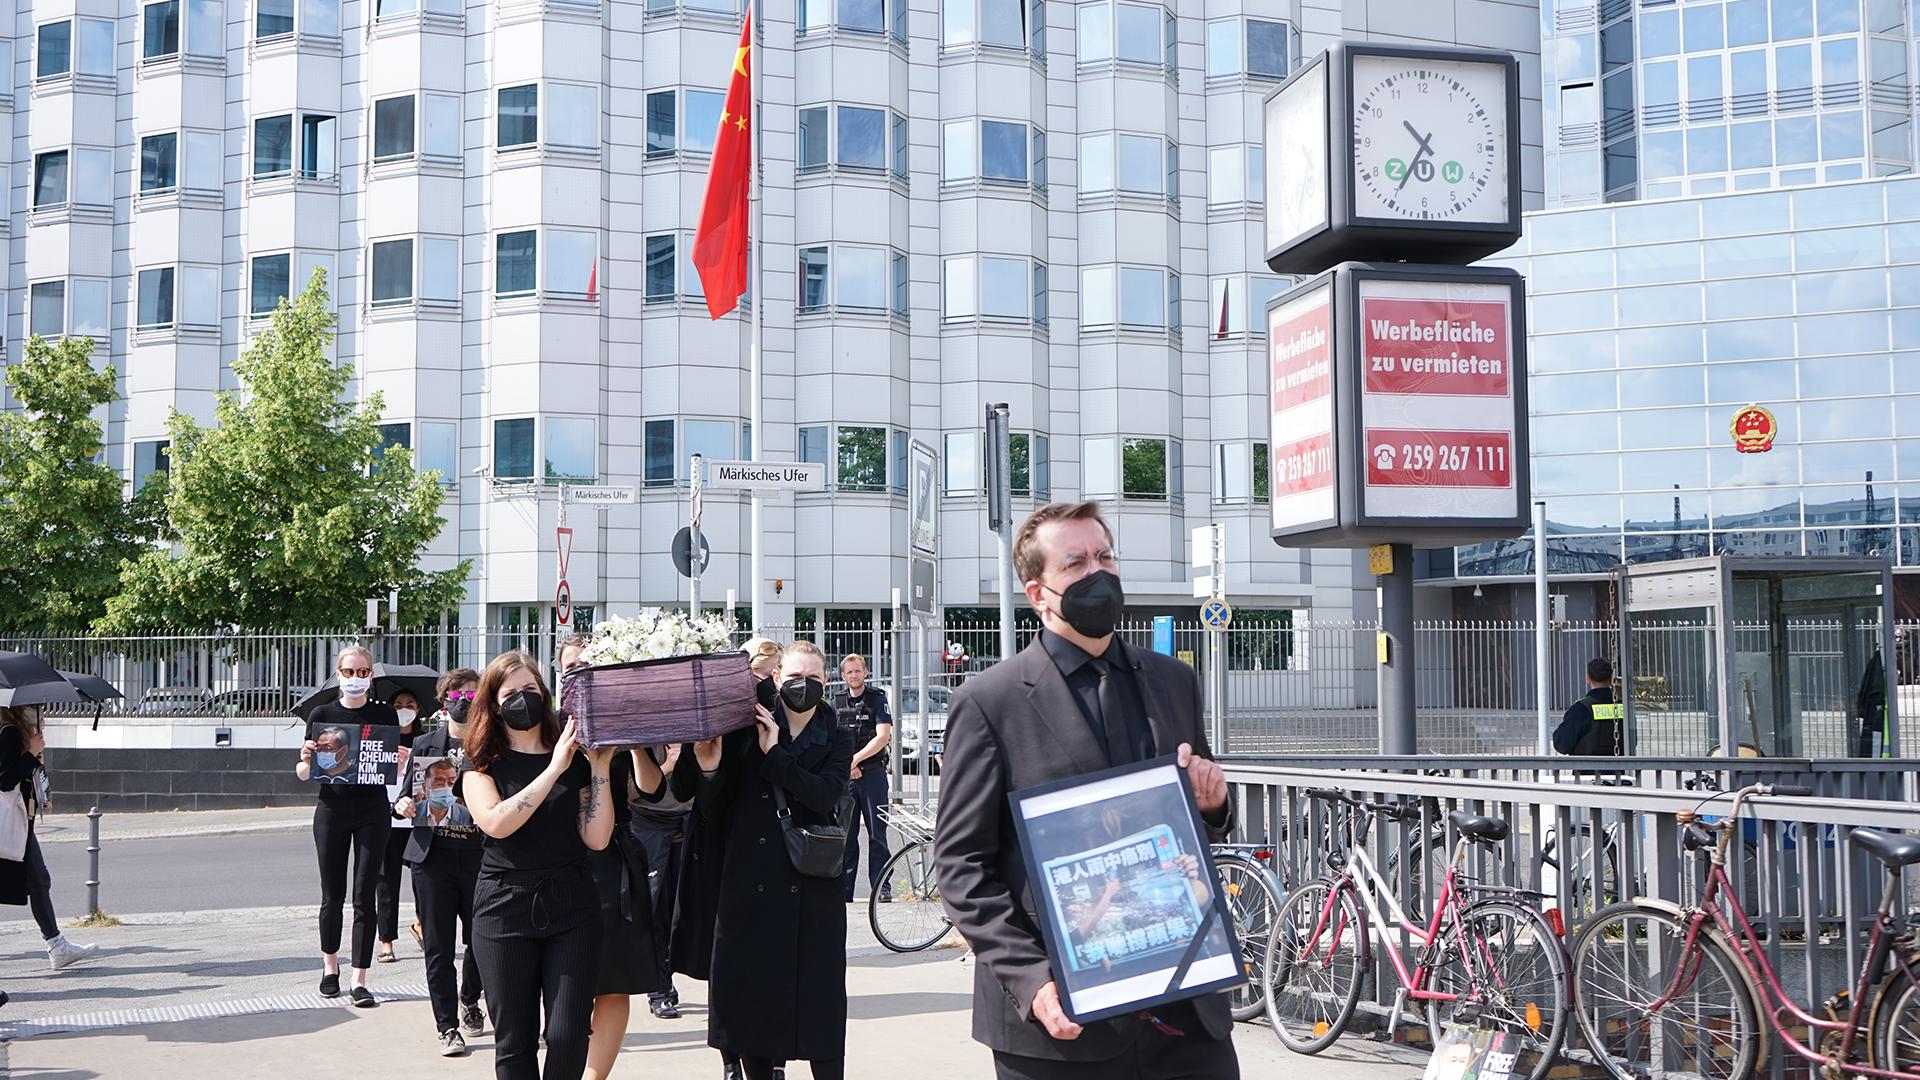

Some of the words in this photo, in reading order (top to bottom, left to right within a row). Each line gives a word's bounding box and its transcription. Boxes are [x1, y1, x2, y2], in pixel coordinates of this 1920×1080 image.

[1417, 83, 1428, 93] 12
[1391, 90, 1401, 100] 11
[1448, 93, 1453, 102] 1
[1372, 108, 1383, 119] 10
[1467, 113, 1474, 123] 2
[1364, 137, 1371, 147] 9
[1476, 143, 1483, 153] 3
[1373, 166, 1379, 177] 8
[1390, 162, 1403, 177] Z
[1417, 163, 1431, 178] U
[1445, 164, 1460, 180] W
[1469, 171, 1475, 181] 4
[1393, 188, 1399, 198] 7
[1450, 191, 1456, 201] 5
[1421, 197, 1428, 207] 6
[1371, 319, 1495, 343] Werbefläche
[1275, 325, 1326, 363] Werbefläche
[1371, 356, 1395, 372] zu
[1401, 353, 1502, 375] vermieten
[1275, 376, 1286, 393] zu
[1287, 360, 1329, 389] vermieten
[1288, 455, 1301, 481] 259
[1302, 450, 1316, 477] 267
[1318, 446, 1331, 473] 111
[1403, 444, 1434, 471] 259
[1439, 445, 1470, 471] 267
[1476, 446, 1505, 472] 111
[720, 466, 780, 481] Märkisches
[783, 468, 808, 482] Ufer
[613, 490, 628, 499] Ufer
[360, 740, 383, 751] FREE
[359, 751, 398, 763] CHEUNG
[358, 762, 377, 774] KIM
[357, 773, 385, 785] HUNG
[1483, 1051, 1516, 1072] FREE
